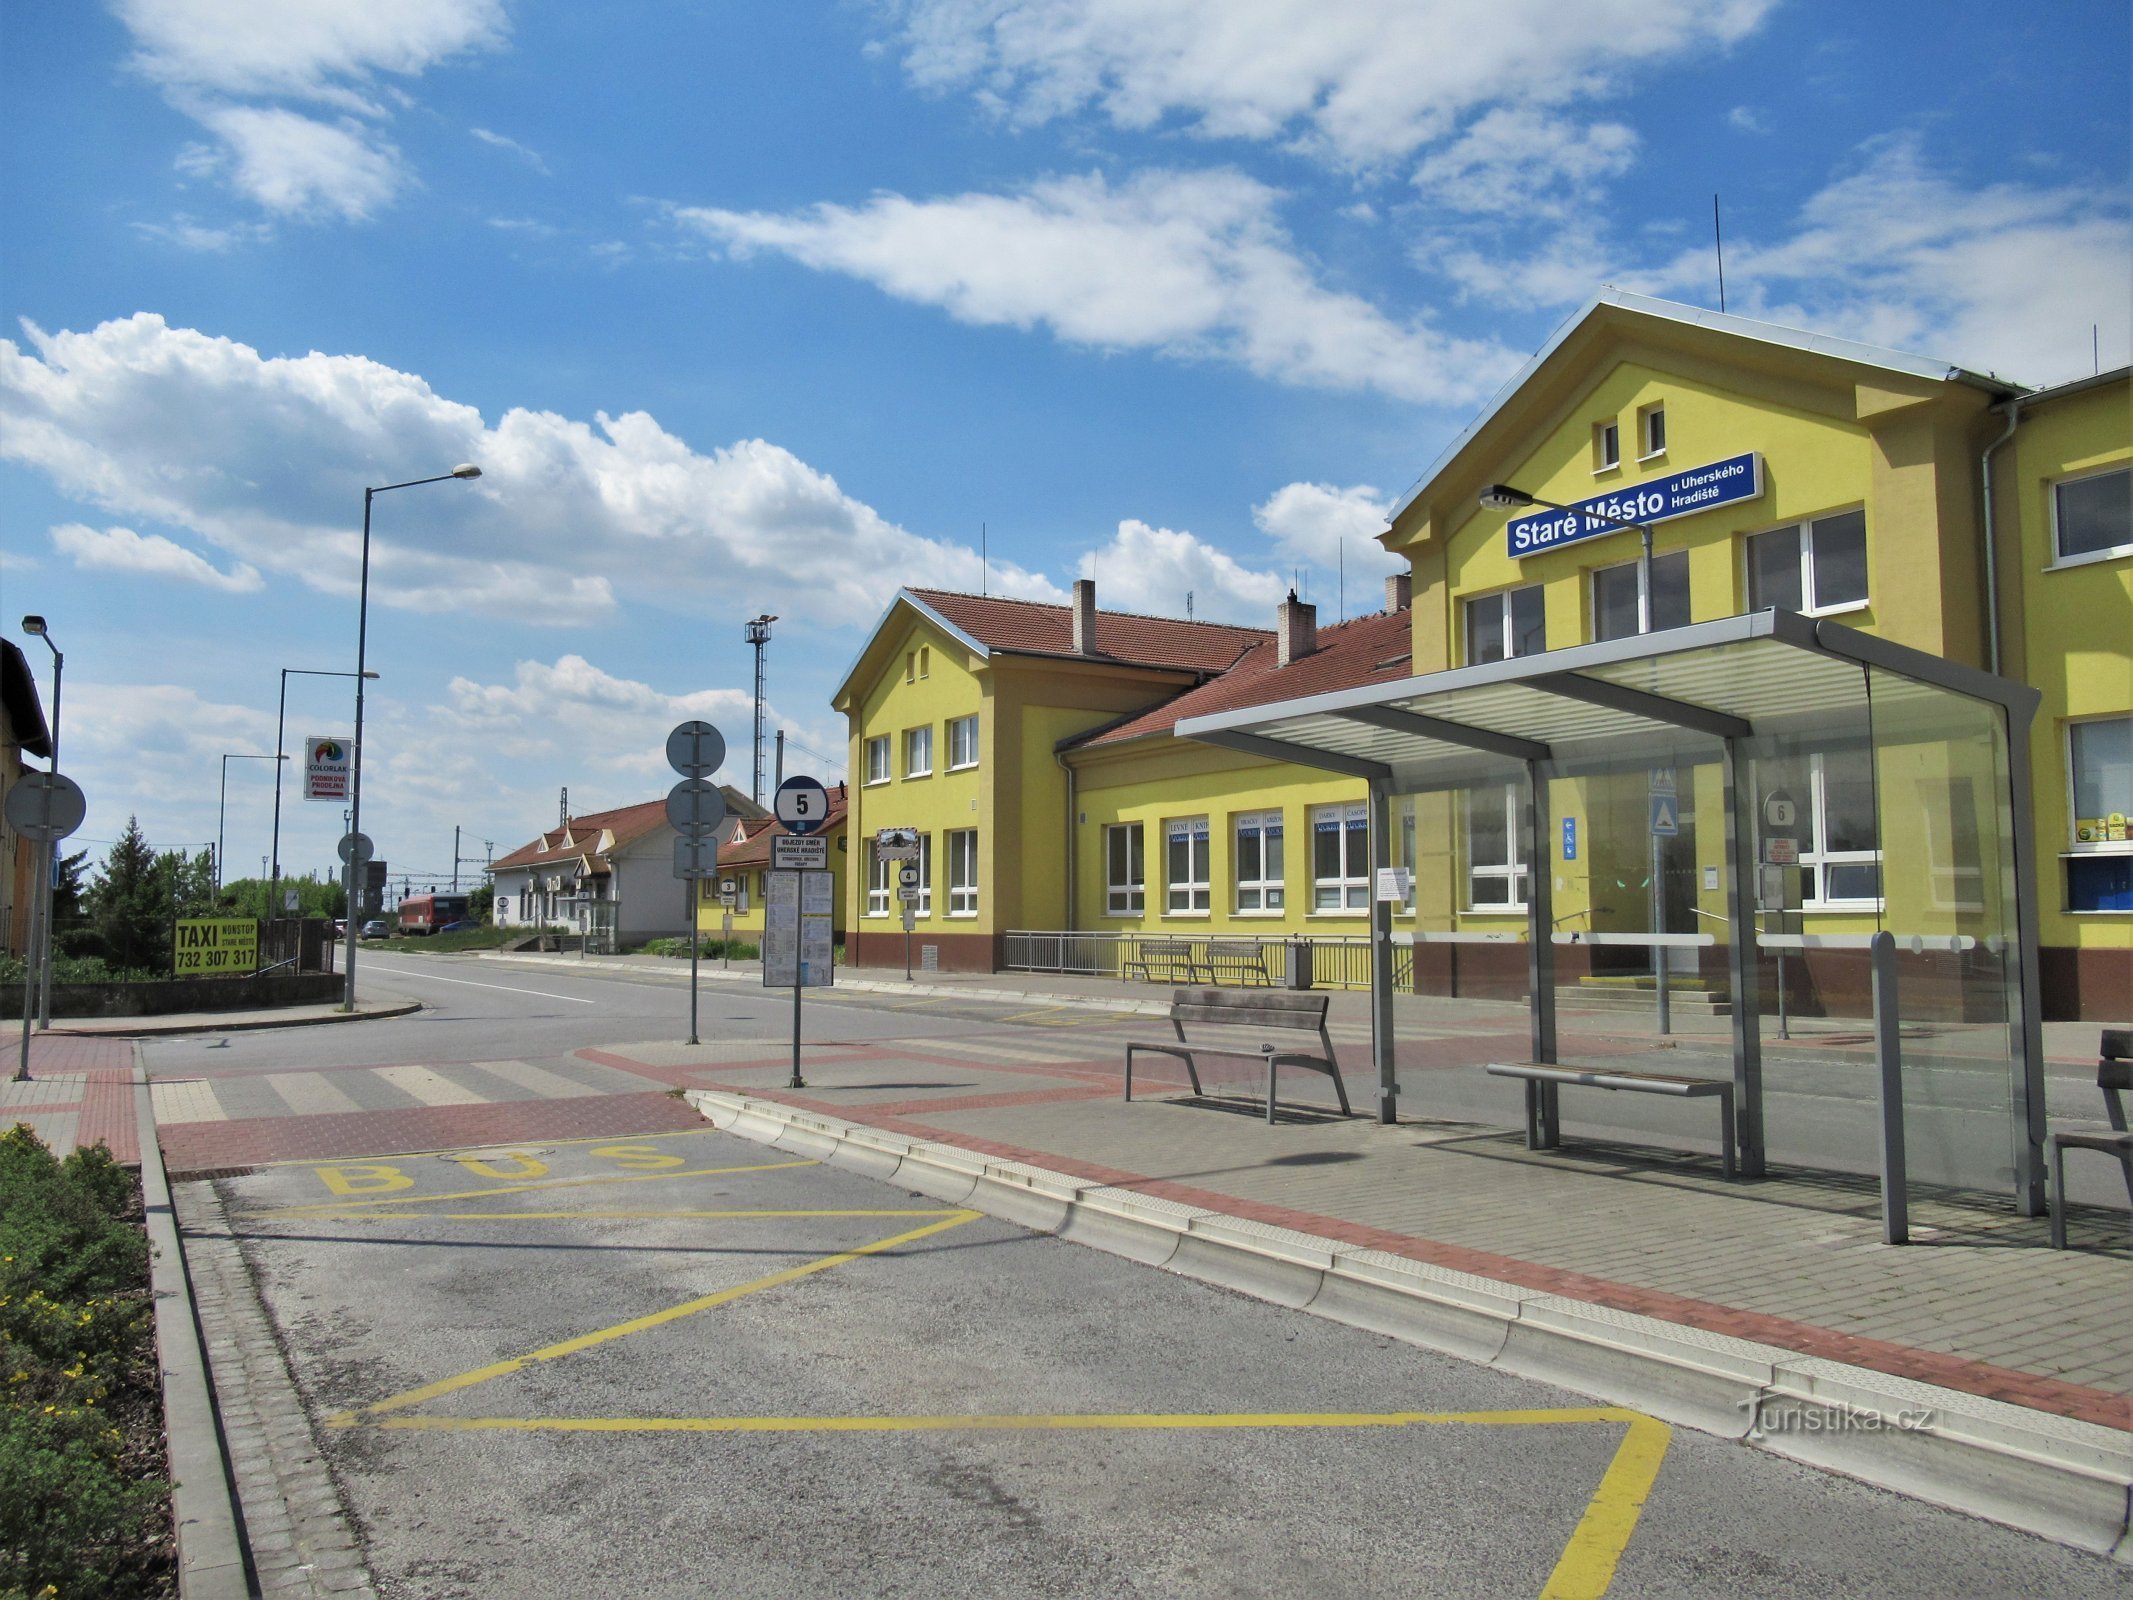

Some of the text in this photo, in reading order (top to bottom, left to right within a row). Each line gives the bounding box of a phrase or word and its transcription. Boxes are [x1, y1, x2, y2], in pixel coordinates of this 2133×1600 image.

[1671, 463, 1744, 493] u Uherského
[1671, 485, 1719, 509] Hradiště
[1514, 490, 1664, 549] Staré Město
[309, 764, 347, 772] COLORLAK
[311, 781, 344, 789] PRODEJNA
[796, 793, 809, 815] 5
[1777, 804, 1785, 821] 6
[777, 846, 800, 854] UHERSKÉ
[905, 871, 911, 881] 4
[726, 883, 731, 891] 3
[177, 924, 255, 948] TAXI NONSTOP
[177, 949, 255, 968] 732 307 317
[315, 1145, 686, 1196] BUS
